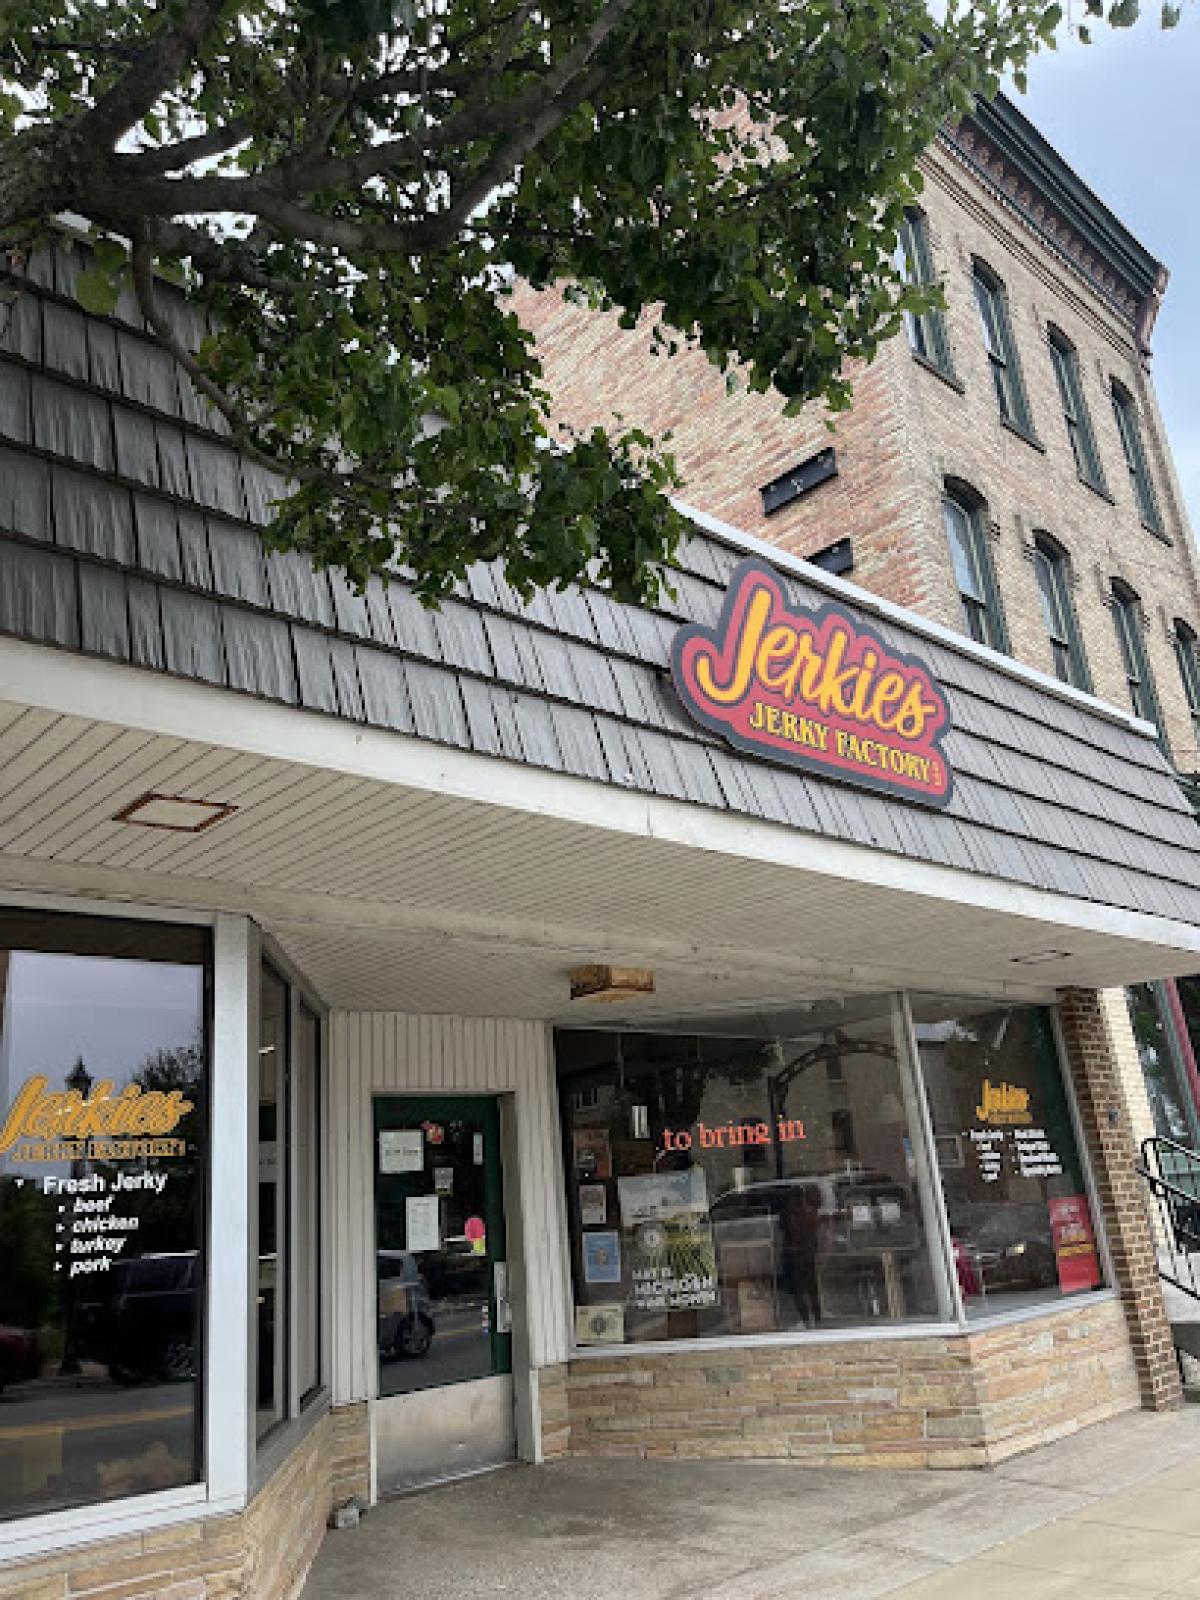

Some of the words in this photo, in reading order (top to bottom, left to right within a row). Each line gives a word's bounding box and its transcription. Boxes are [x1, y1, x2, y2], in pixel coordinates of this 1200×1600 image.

[697, 588, 937, 739] Jerkies
[749, 702, 829, 751] JERKY
[835, 730, 931, 785] FACTORY
[663, 1128, 692, 1150] to
[697, 1121, 771, 1149] bring
[779, 1113, 806, 1142] in
[43, 1173, 104, 1194] Fresh
[111, 1170, 168, 1194] Jerky
[73, 1194, 115, 1212] beef
[73, 1215, 139, 1233] chicken
[70, 1235, 127, 1253] turkey
[70, 1256, 112, 1278] pork
